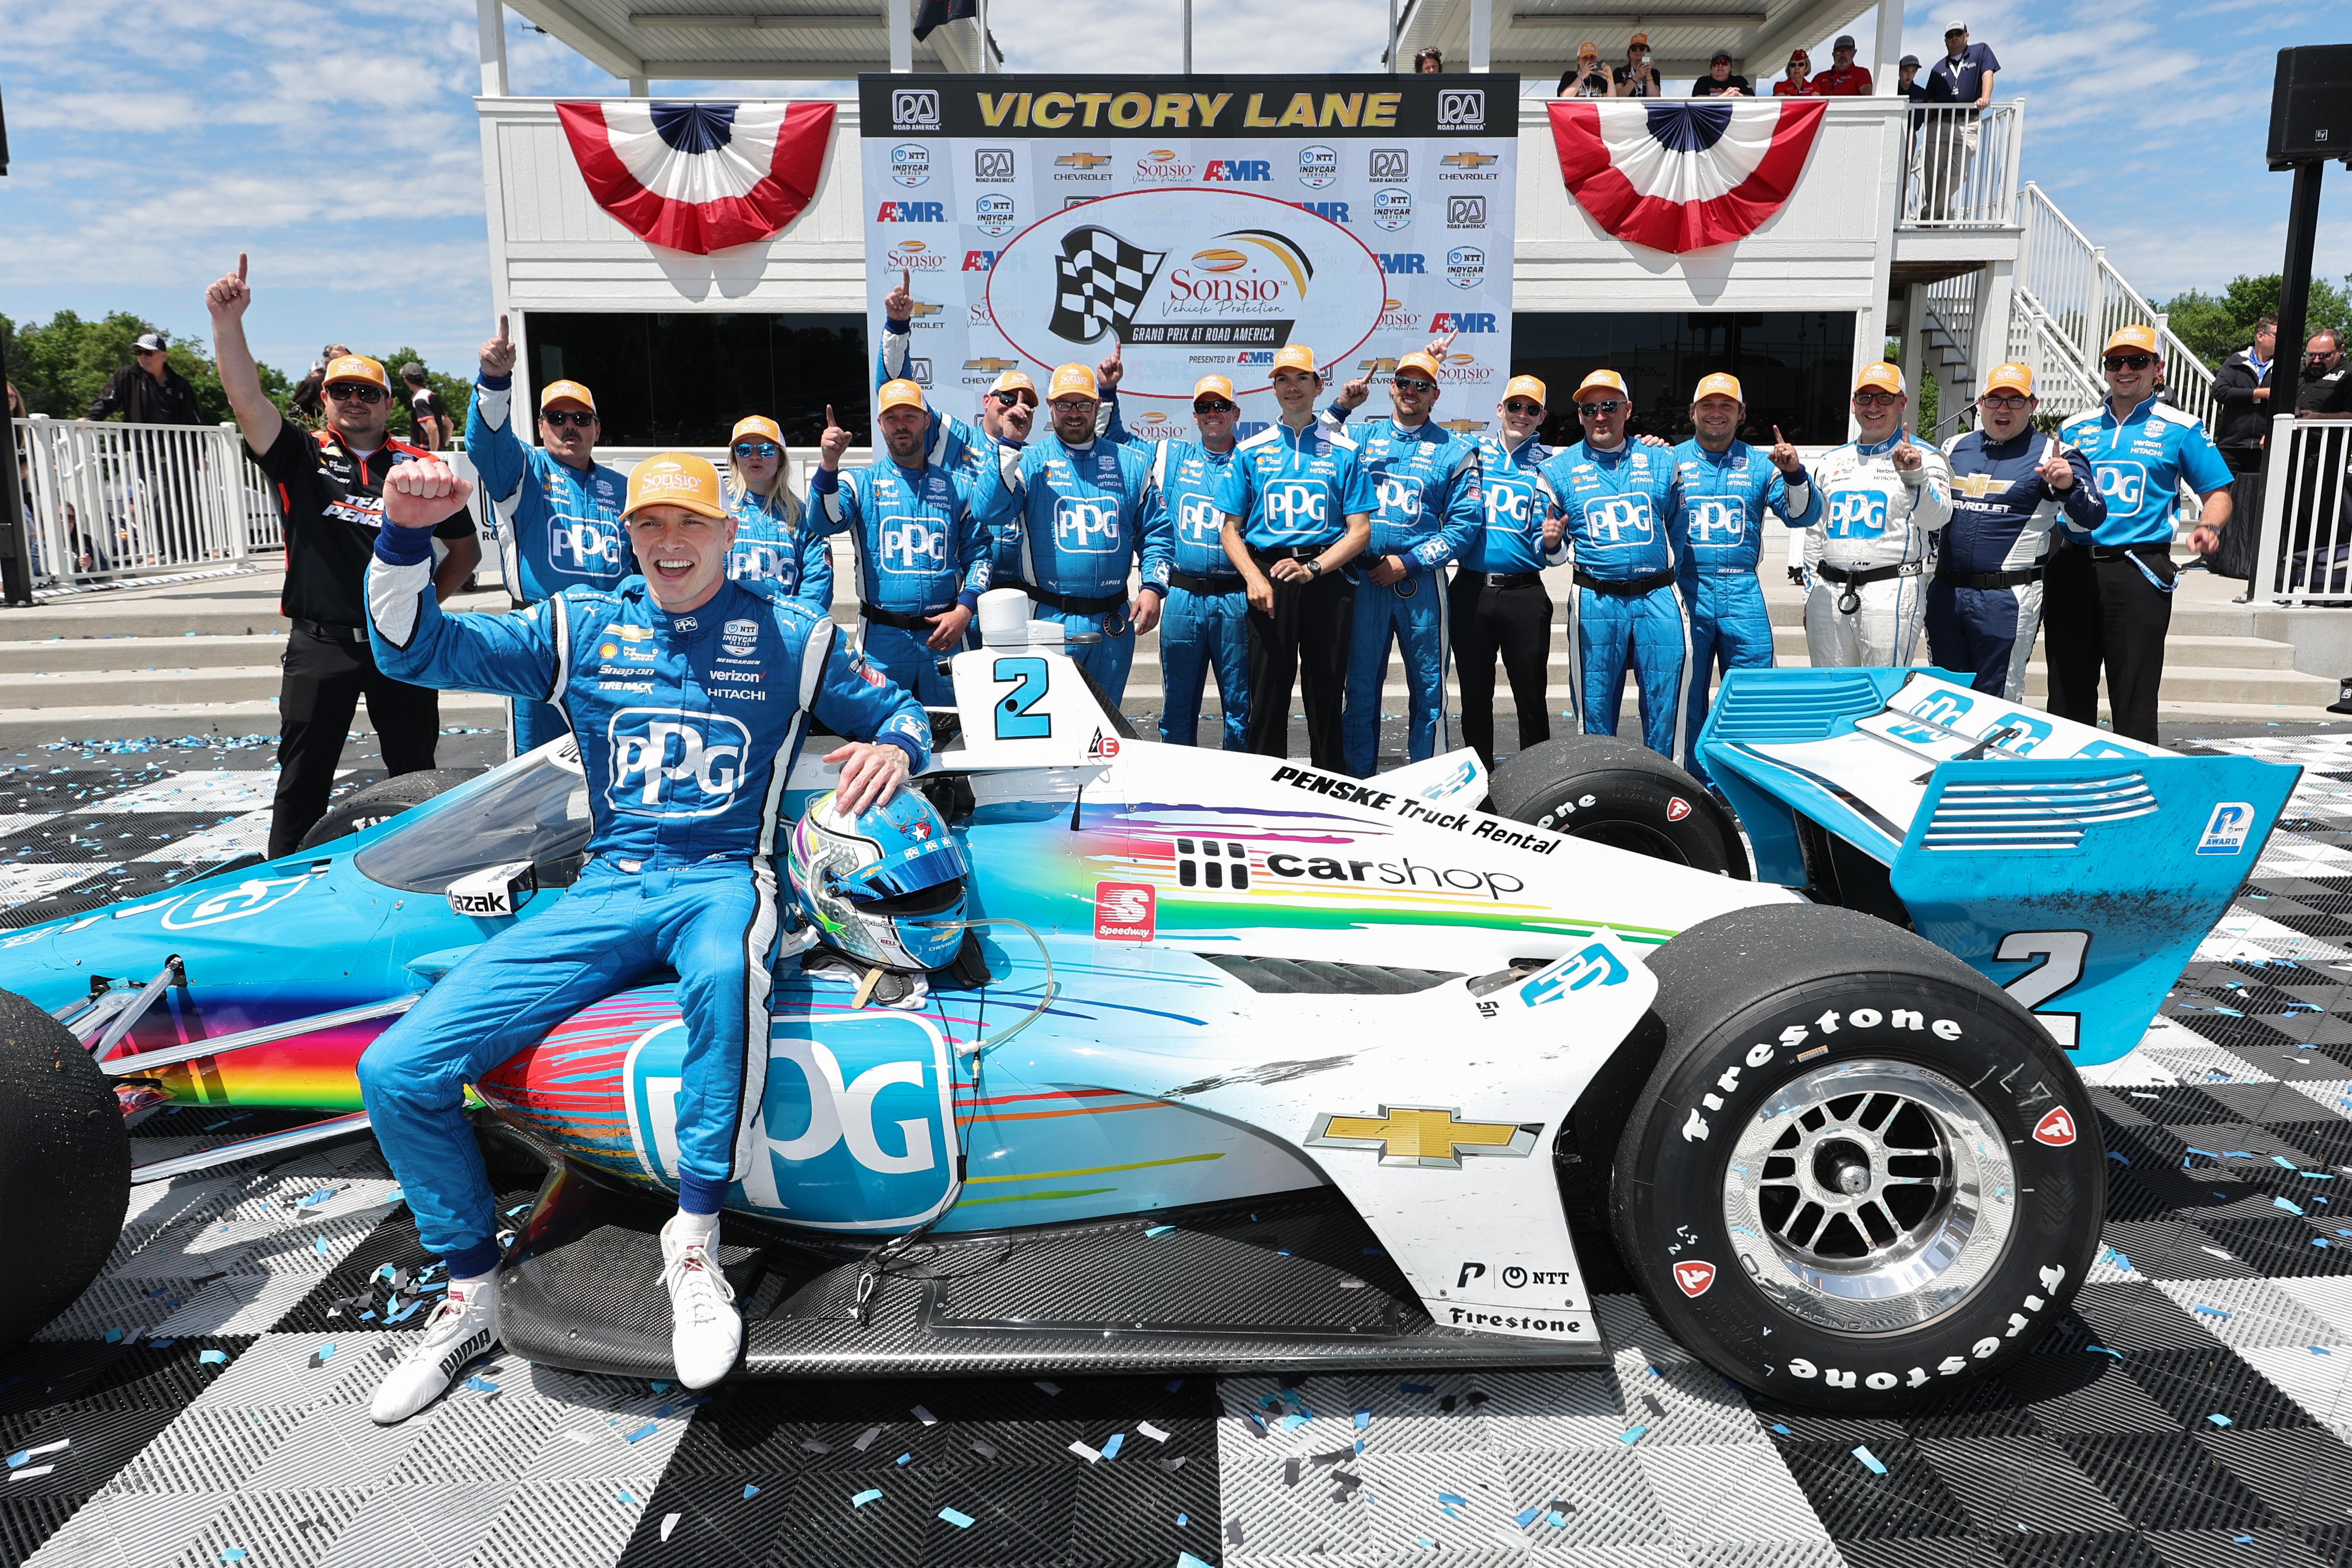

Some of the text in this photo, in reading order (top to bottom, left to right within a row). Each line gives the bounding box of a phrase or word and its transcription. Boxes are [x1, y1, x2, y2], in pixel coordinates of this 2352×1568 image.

[976, 92, 1402, 128] VICTORY LANE
[1136, 159, 1192, 176] Sonsio
[1202, 160, 1271, 181] AMR
[1133, 175, 1194, 184] Vehicle Protection
[876, 202, 945, 222] AMR
[888, 250, 942, 266] Sonsio
[1170, 268, 1280, 301] Sonsio
[1162, 298, 1284, 317] Vehicle Protection
[1428, 312, 1496, 333] AMR
[1132, 327, 1275, 342] GRAND PRIX AT ROAD AMERICA
[1237, 352, 1274, 363] AMR
[338, 362, 373, 374] Sonsio
[1130, 422, 1183, 438] Sonsio
[2130, 448, 2163, 457] HITACHI
[2133, 440, 2162, 448] verizon
[1409, 463, 1433, 472] HITACHI
[1412, 456, 1432, 464] verizon
[642, 471, 698, 489] Sonsio
[1310, 468, 1337, 476] HITACHI
[1268, 485, 1326, 528] PPG
[1827, 494, 1885, 536] PPG
[1060, 504, 1118, 546] PPG
[1589, 500, 1650, 541] PPG
[553, 524, 619, 567] PPG
[885, 523, 944, 566] PPG
[676, 619, 696, 631] PPG
[722, 634, 757, 643] INDYCAR
[623, 650, 656, 658] V-Power
[598, 665, 655, 677] Snap-on
[709, 669, 760, 683] verizon
[598, 681, 655, 695] TIRE RACK
[707, 688, 766, 701] HITACHI
[992, 657, 1052, 740] 2
[1102, 739, 1115, 755] E
[615, 721, 740, 805] PPG
[1270, 765, 1397, 811] PENSKE
[1397, 798, 1469, 833] Truck
[1472, 819, 1562, 855] Rental
[1266, 853, 1524, 901] carshop
[1099, 925, 1150, 937] Speedway
[880, 938, 897, 947] BELL
[928, 935, 962, 952] CHEVROLET
[1993, 929, 2092, 1050] 2
[1681, 1007, 1963, 1143] Firestone
[1532, 1271, 1570, 1285] NTT
[1449, 1307, 1582, 1334] Firestone
[1787, 1263, 2067, 1391] Firestone
[438, 1326, 490, 1381] PUMA
